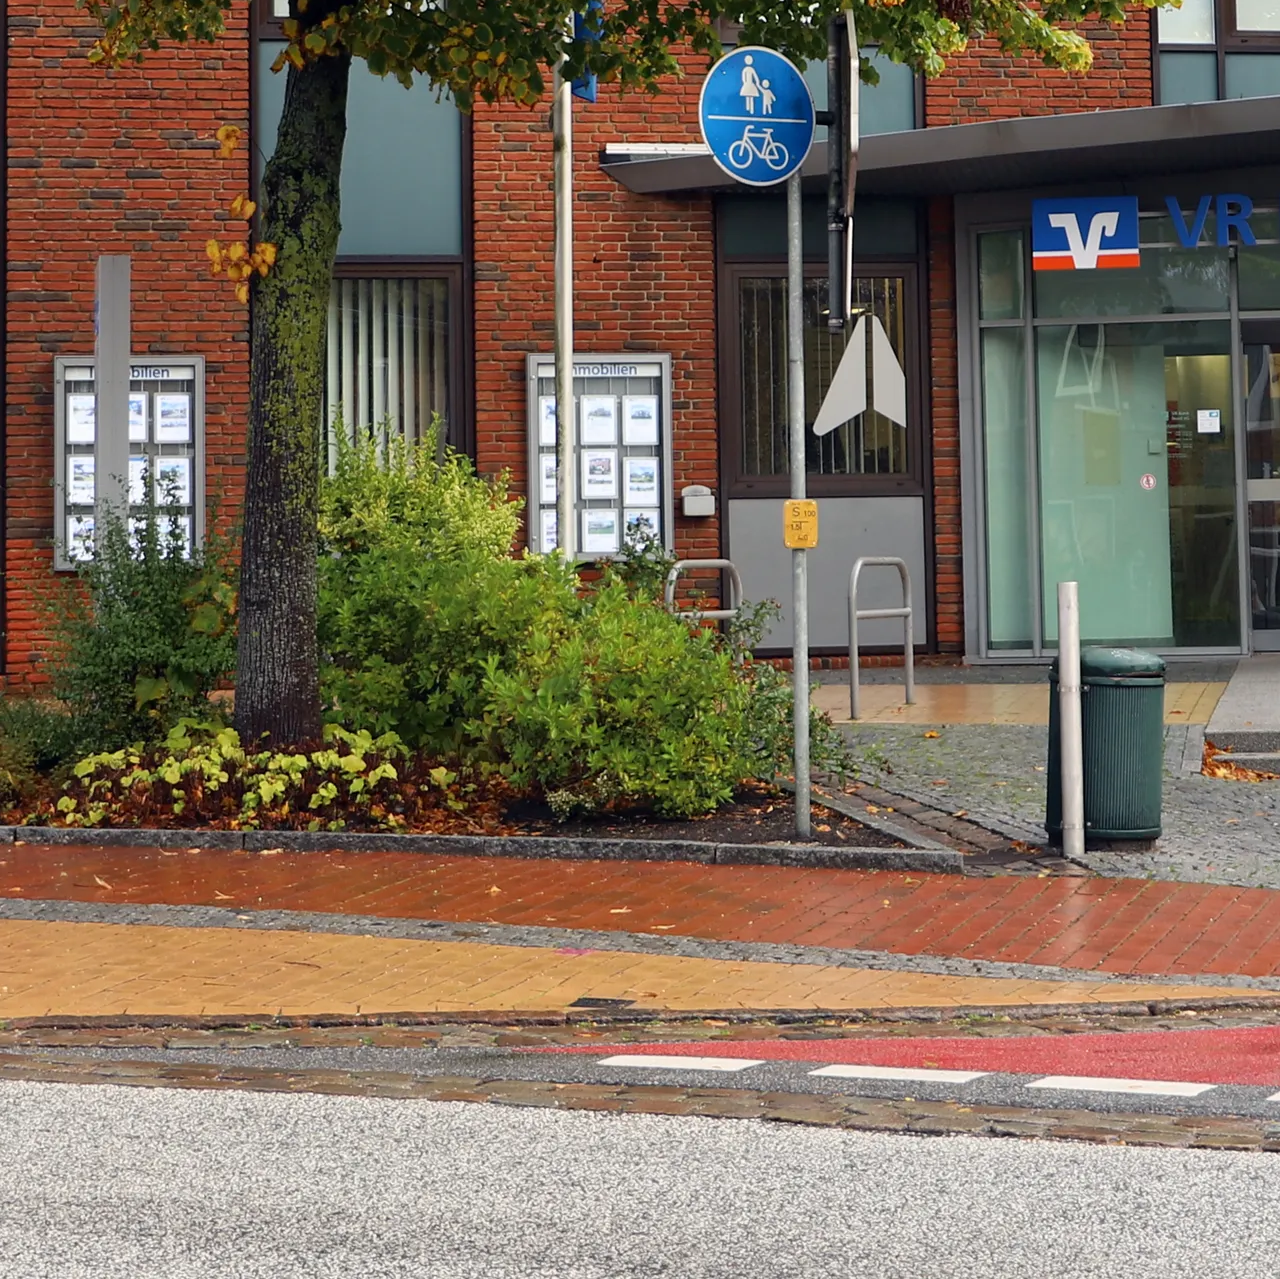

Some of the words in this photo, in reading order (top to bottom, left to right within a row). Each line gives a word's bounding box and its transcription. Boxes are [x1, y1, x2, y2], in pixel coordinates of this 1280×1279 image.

[1164, 193, 1257, 248] VR
[88, 366, 170, 379] Ibilien
[792, 506, 801, 517] S
